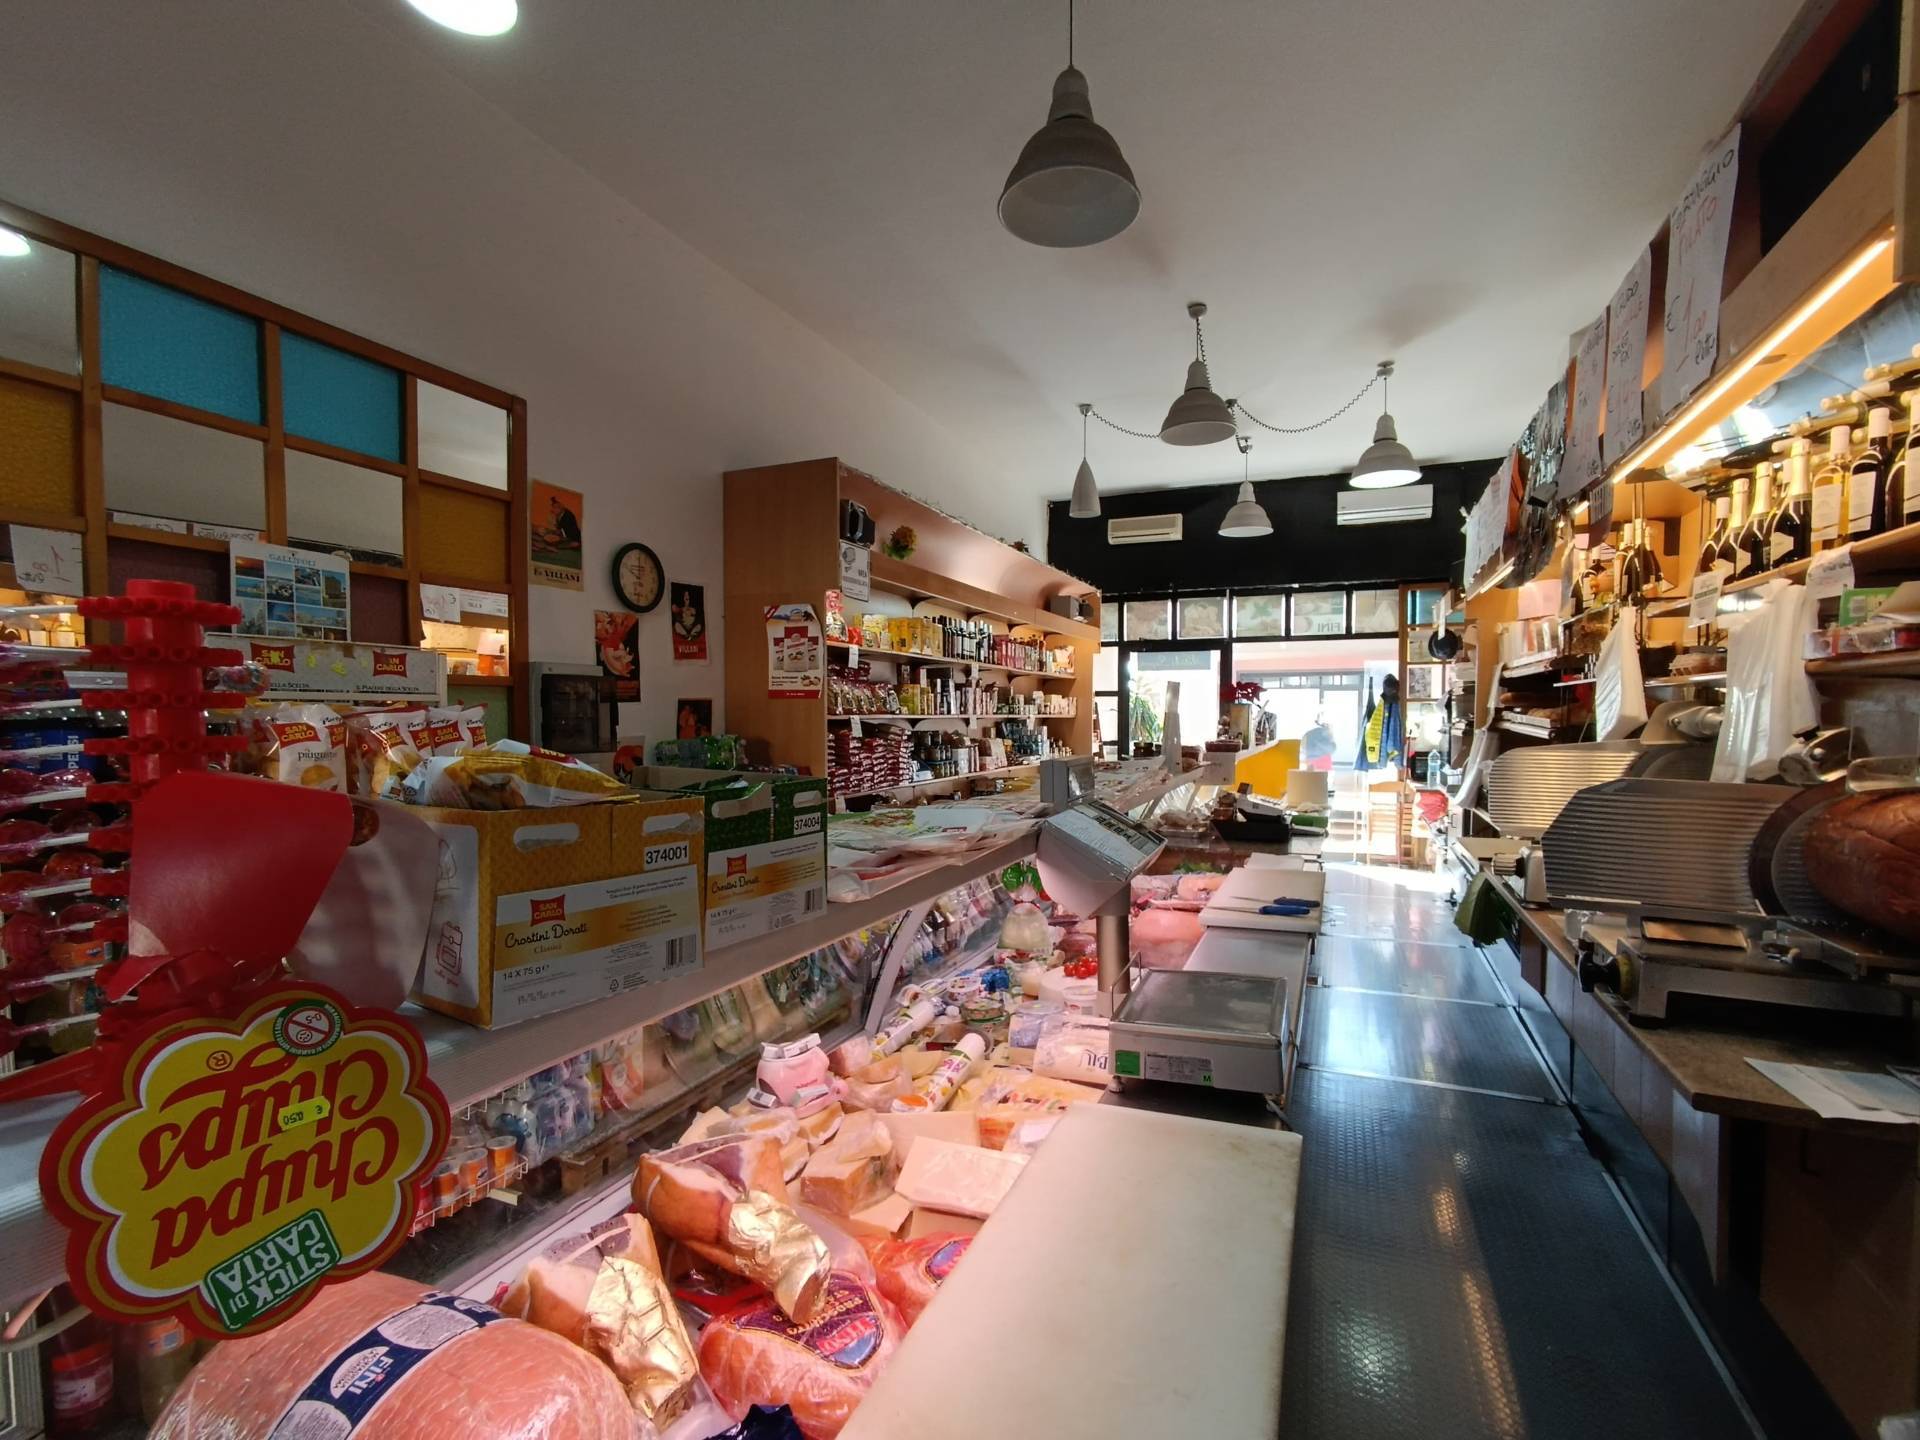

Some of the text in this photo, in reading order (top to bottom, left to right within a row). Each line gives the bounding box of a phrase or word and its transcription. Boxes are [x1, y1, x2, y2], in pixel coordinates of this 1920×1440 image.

[544, 567, 580, 582] VILLANI
[281, 731, 316, 743] CARLO
[285, 725, 307, 735] SAN
[436, 727, 454, 736] SAN
[433, 733, 459, 744] CARLO
[67, 735, 79, 769] PESI
[793, 816, 821, 831] 374004
[645, 845, 689, 865] 374001
[538, 901, 558, 910] SAN
[534, 908, 564, 920] CARLO
[505, 923, 588, 948] Crostini Dorati
[503, 972, 513, 981] 14
[523, 967, 534, 977] 75
[305, 1012, 323, 1025] 0-5
[315, 1104, 323, 1114] €
[150, 1115, 400, 1271] Chupa
[216, 1218, 328, 1290] CARTA
[230, 1239, 334, 1313] STICK DI
[348, 1356, 394, 1395] FINI
